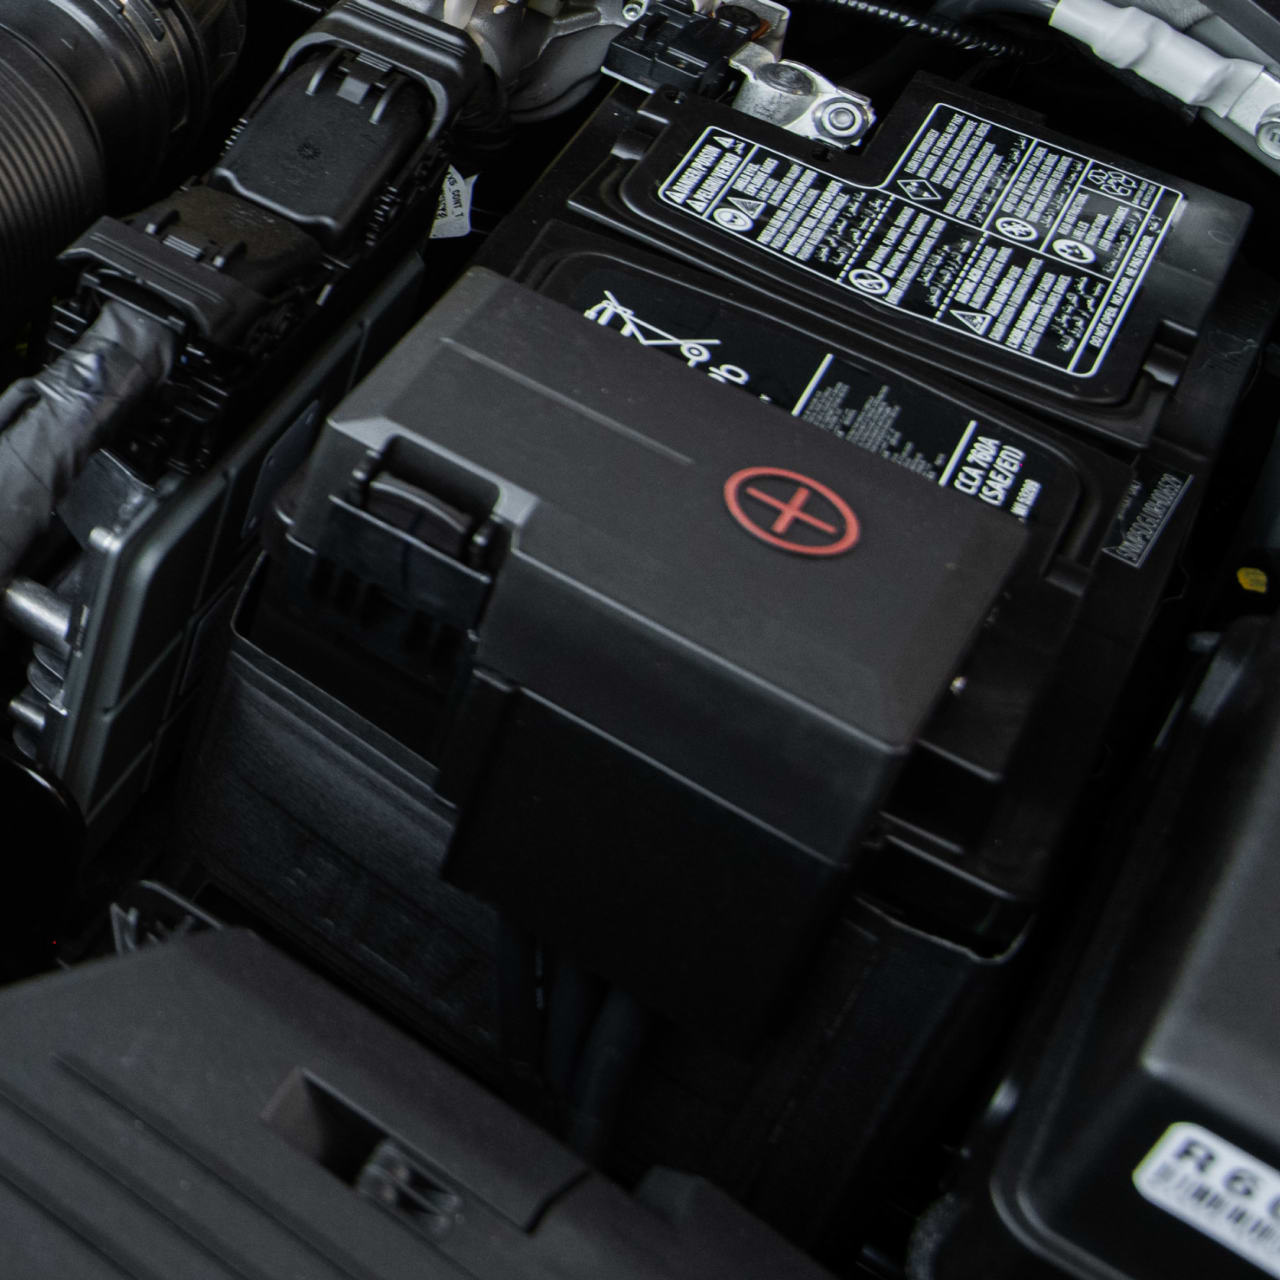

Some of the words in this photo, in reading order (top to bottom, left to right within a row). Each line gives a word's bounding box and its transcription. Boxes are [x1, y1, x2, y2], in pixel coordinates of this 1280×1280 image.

[670, 141, 722, 196] DANGER/POISON
[691, 149, 743, 204] PELIGRO/VENENO
[967, 435, 1002, 469] 760A
[954, 466, 986, 496] CCA
